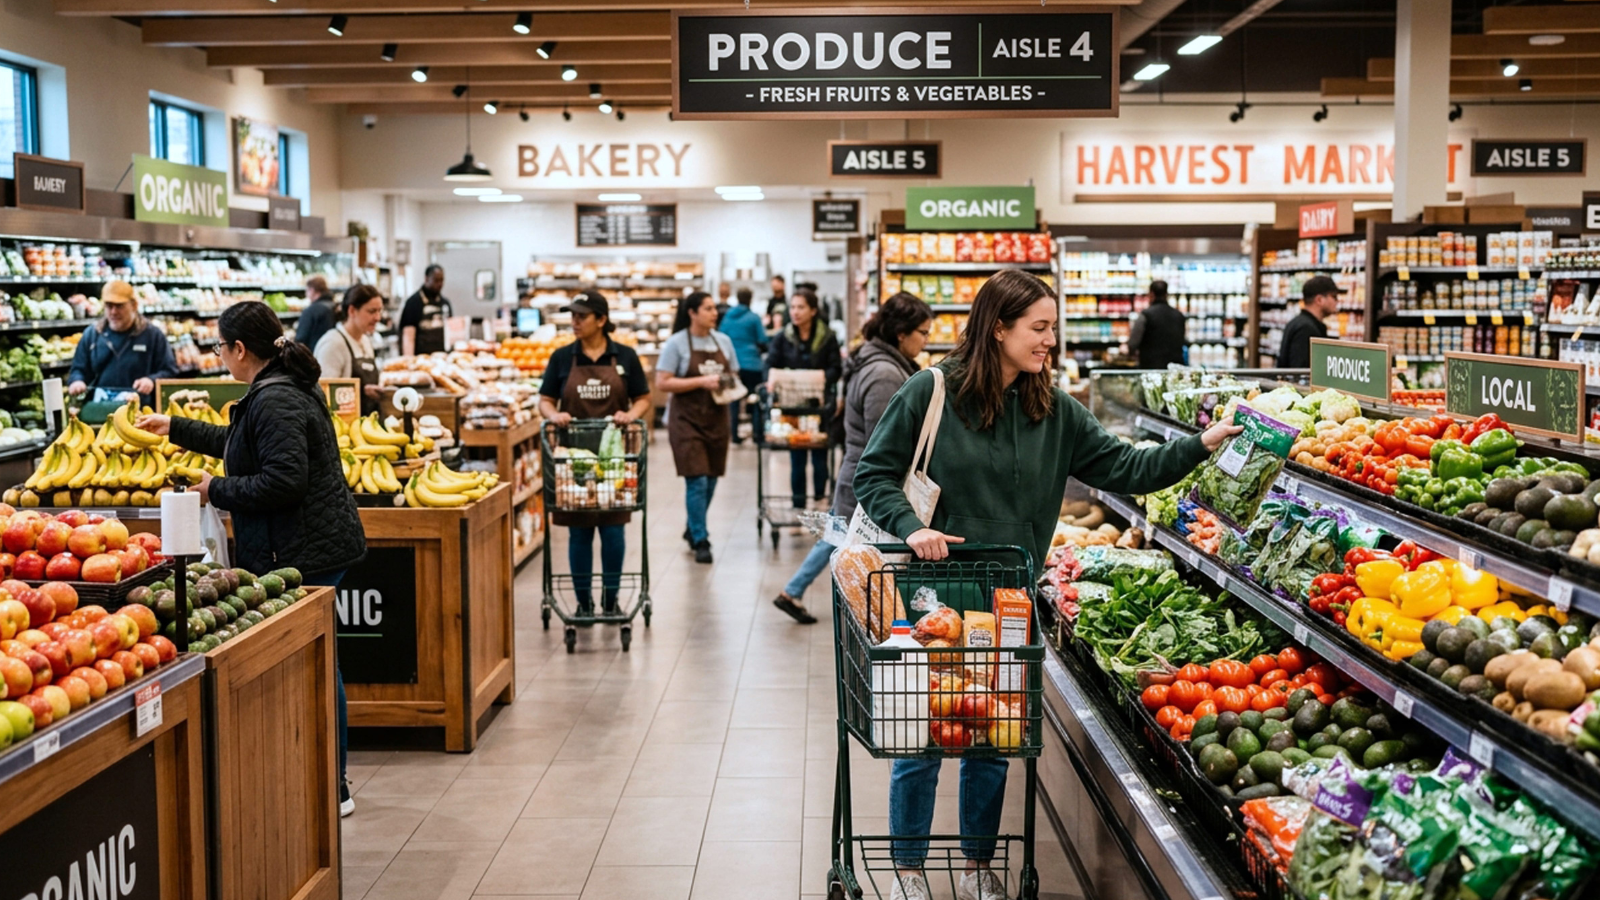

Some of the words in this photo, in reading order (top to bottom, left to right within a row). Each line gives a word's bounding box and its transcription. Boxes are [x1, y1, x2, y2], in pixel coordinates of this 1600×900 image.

[708, 31, 952, 71] PRODUCE
[992, 38, 1062, 59] AISLE
[1069, 31, 1094, 62] 4
[759, 86, 821, 103] FRESH
[826, 86, 892, 103] FRUITS
[896, 85, 910, 102] &
[913, 85, 1033, 102] VEGETABLES
[517, 143, 691, 178] BAKERY
[842, 150, 907, 170] AISLE
[912, 150, 926, 169] 5
[1076, 144, 1254, 185] HARVEST
[1283, 144, 1463, 184] MARKT
[1486, 148, 1551, 168] AISLE
[1557, 148, 1570, 167] 5
[140, 172, 225, 219] ORGANIC
[919, 199, 1021, 219] ORGANIC
[1326, 355, 1371, 384] PRODUCE
[1481, 375, 1536, 413] LOCAL
[20, 823, 137, 900] ANIC
